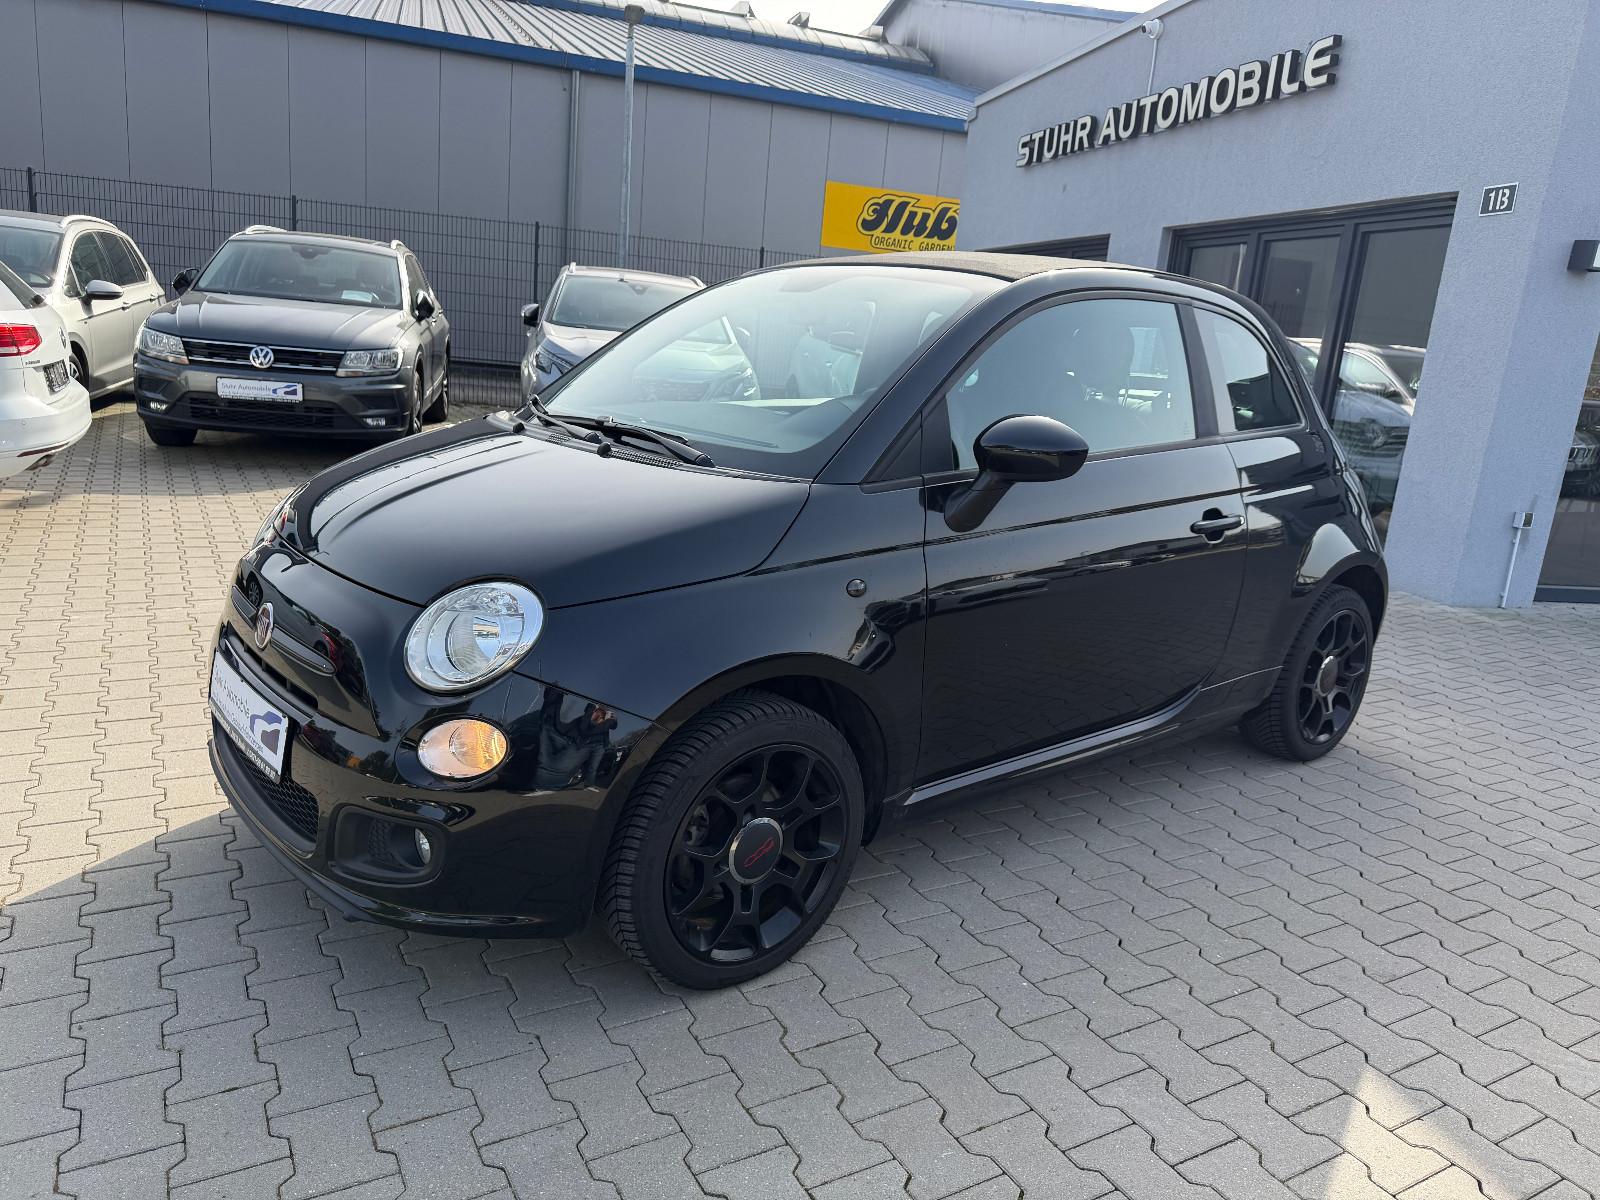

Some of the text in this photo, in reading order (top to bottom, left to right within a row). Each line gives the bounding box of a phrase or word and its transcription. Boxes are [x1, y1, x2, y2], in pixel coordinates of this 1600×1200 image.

[1015, 34, 1343, 168] STUHR AUTOMOBILE
[873, 235, 914, 251] ORGANIC
